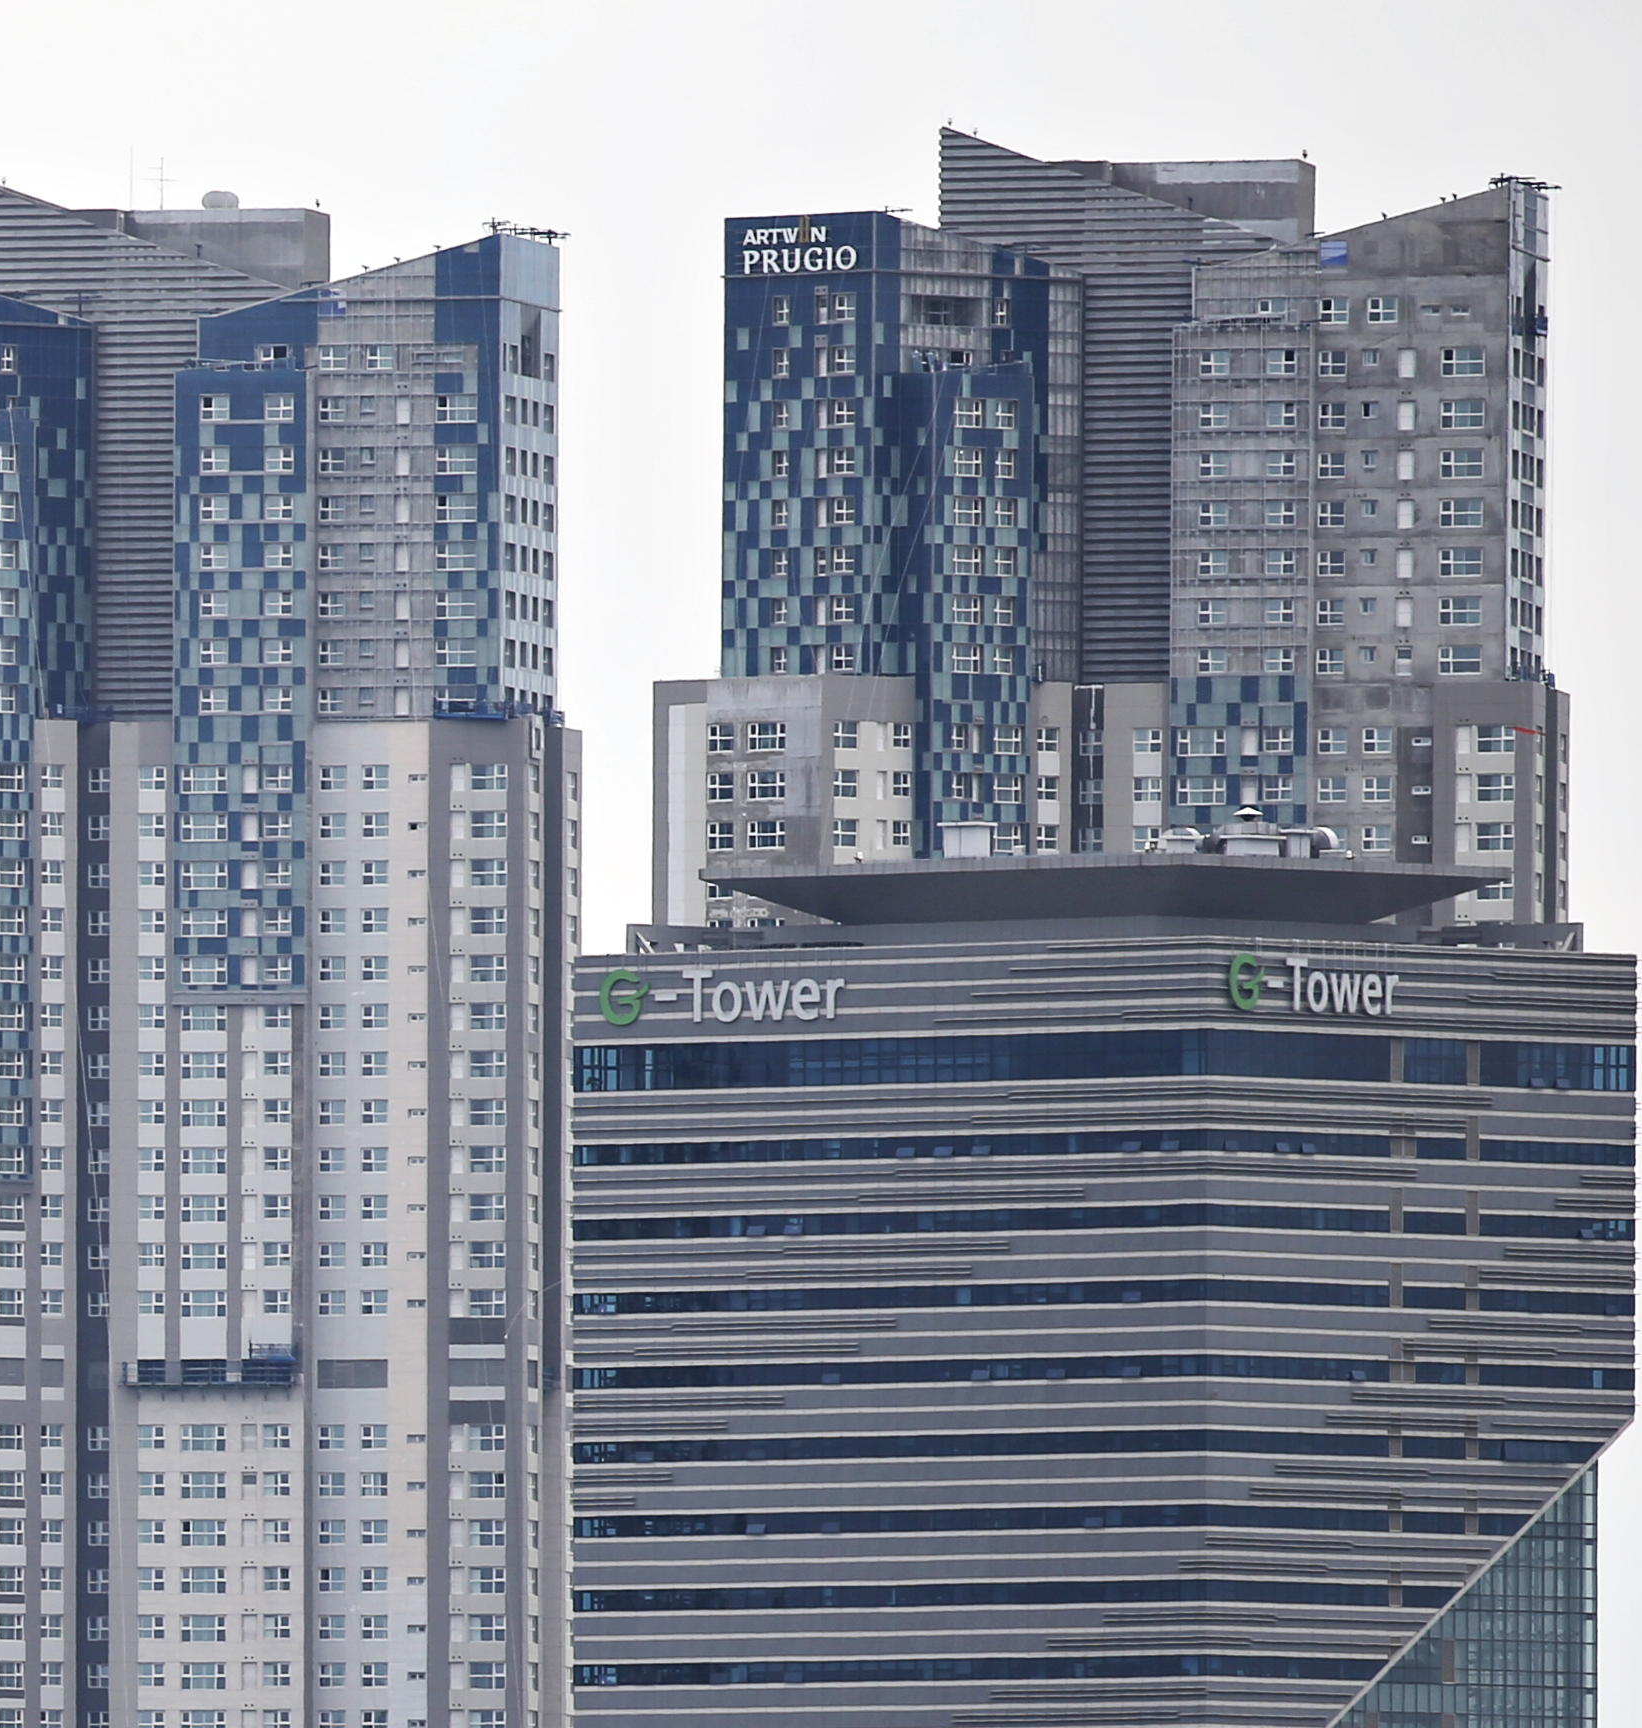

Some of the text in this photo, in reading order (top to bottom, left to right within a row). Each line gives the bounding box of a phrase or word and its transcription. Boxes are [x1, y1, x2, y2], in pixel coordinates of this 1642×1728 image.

[743, 245, 857, 274] PRUGIO
[599, 969, 845, 1026] G-Tower
[1229, 953, 1399, 1016] G-Tower
